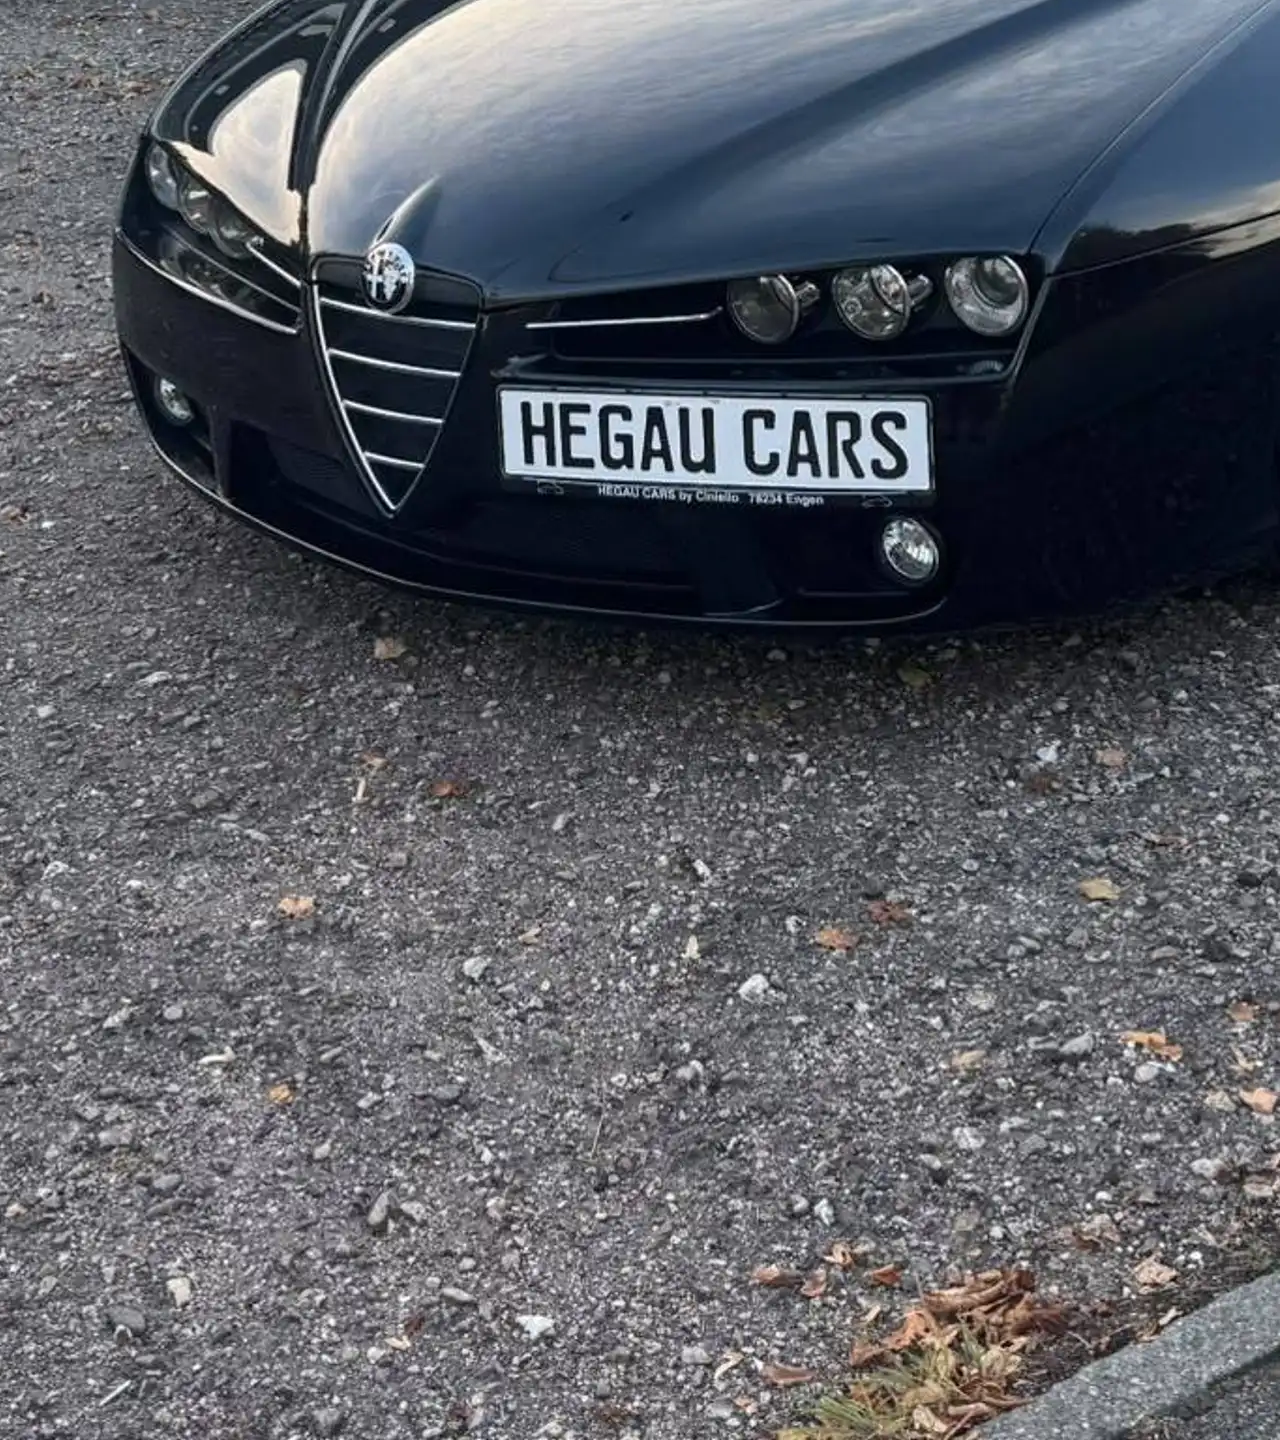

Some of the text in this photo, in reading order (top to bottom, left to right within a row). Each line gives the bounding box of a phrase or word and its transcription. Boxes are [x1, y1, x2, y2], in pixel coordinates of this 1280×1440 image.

[521, 401, 909, 480] HEGAU CARS
[598, 483, 640, 498] HEGAU
[642, 486, 676, 500] CARS
[679, 490, 693, 505] by
